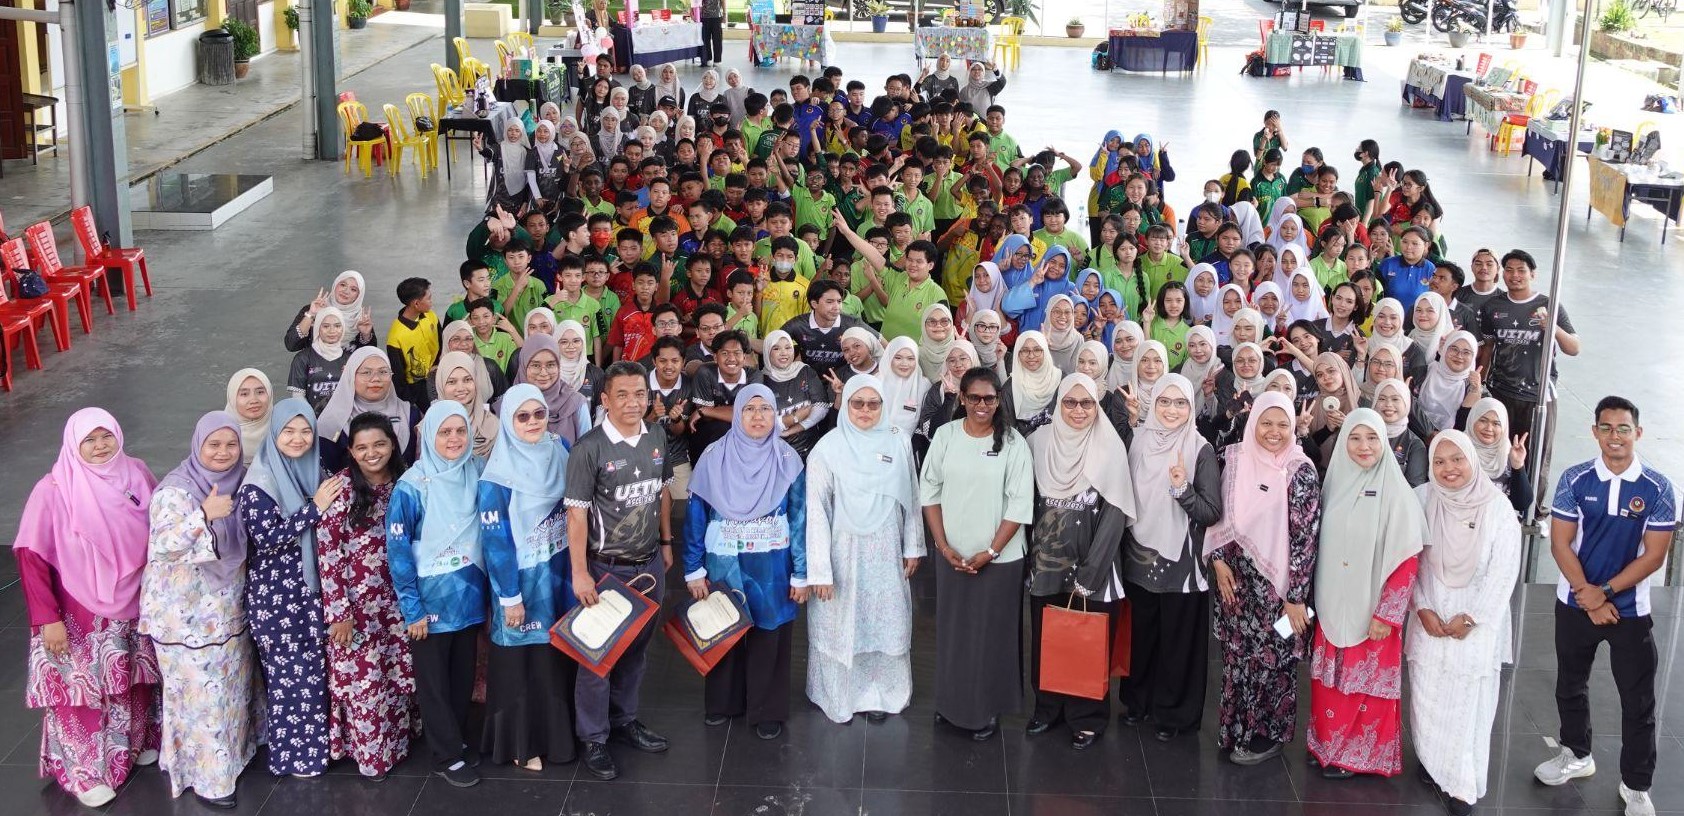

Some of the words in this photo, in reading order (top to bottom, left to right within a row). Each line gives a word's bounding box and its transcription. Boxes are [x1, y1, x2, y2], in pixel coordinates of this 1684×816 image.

[1496, 329, 1540, 342] UITM
[313, 381, 339, 392] UIT
[520, 621, 542, 632] CREW
